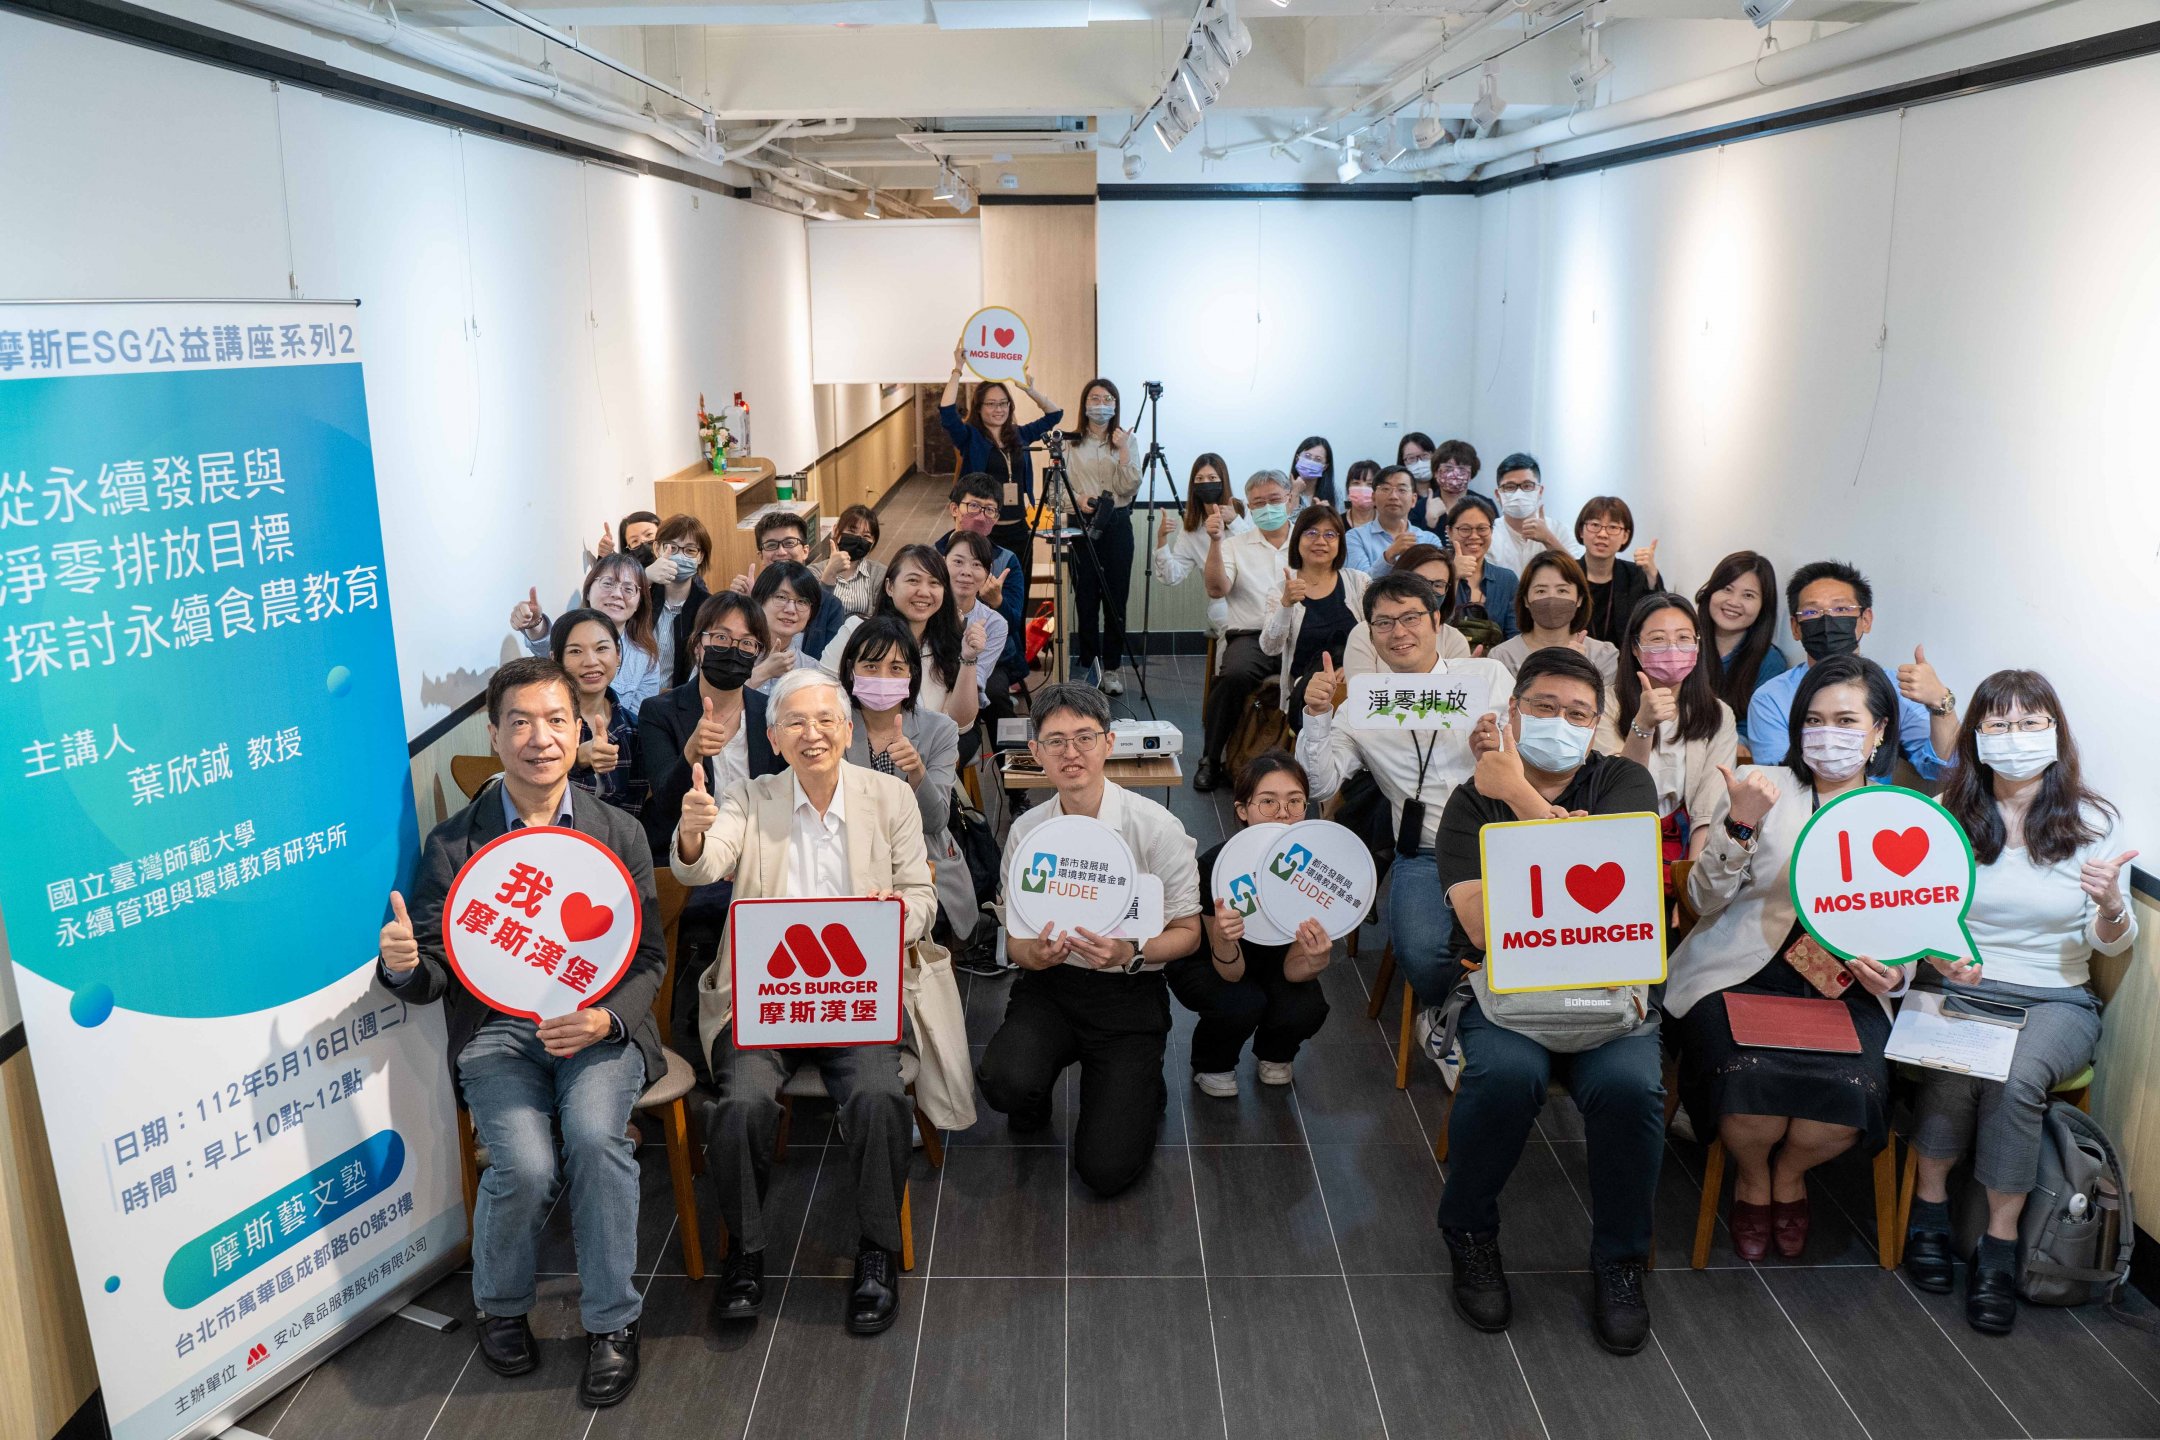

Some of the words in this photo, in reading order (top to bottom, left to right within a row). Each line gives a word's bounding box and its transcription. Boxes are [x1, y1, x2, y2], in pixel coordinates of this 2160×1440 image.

[0, 323, 355, 371] 摩斯ESG公益講座系列2
[970, 350, 989, 358] MOS
[990, 352, 1023, 361] BURGER
[981, 325, 986, 346] I
[0, 448, 285, 529] 從永續發展與
[0, 513, 294, 605] 淨零排放目標
[3, 565, 379, 683] 探討永續食農教育
[1368, 689, 1468, 711] 淨零排放
[22, 723, 135, 778] 主講人
[127, 742, 233, 806] 葉欣誠
[247, 726, 303, 770] 教授
[47, 819, 255, 912] 國立臺灣師範大學
[1057, 868, 1127, 886] 環境教育基金會
[1059, 857, 1109, 872] 都市發展與
[1311, 858, 1353, 890] 都市發展與
[1838, 830, 1852, 883] I
[56, 823, 348, 947] 永續管理與環境教育研究所
[494, 862, 553, 919] 我
[1048, 881, 1099, 900] FUDEE
[1290, 873, 1335, 910] FUDEE
[1305, 866, 1362, 909] 環境教育基金會
[1530, 864, 1544, 918] I
[1814, 893, 1866, 914] MOS
[1870, 885, 1960, 909] BURGER
[456, 898, 599, 994] 摩斯漢堡
[1502, 928, 1557, 950] MOS
[1561, 922, 1654, 946] BURGER
[758, 982, 801, 996] MOS
[805, 981, 878, 995] BURGER
[759, 999, 877, 1024] 摩斯漢堡
[210, 1158, 368, 1278] 摩斯藝文塾
[174, 1191, 415, 1358] 台北市萬華區成都路60號3樓
[175, 1364, 238, 1416] 主辦單位
[274, 1236, 428, 1349] 安心食品服務股份有限公司
